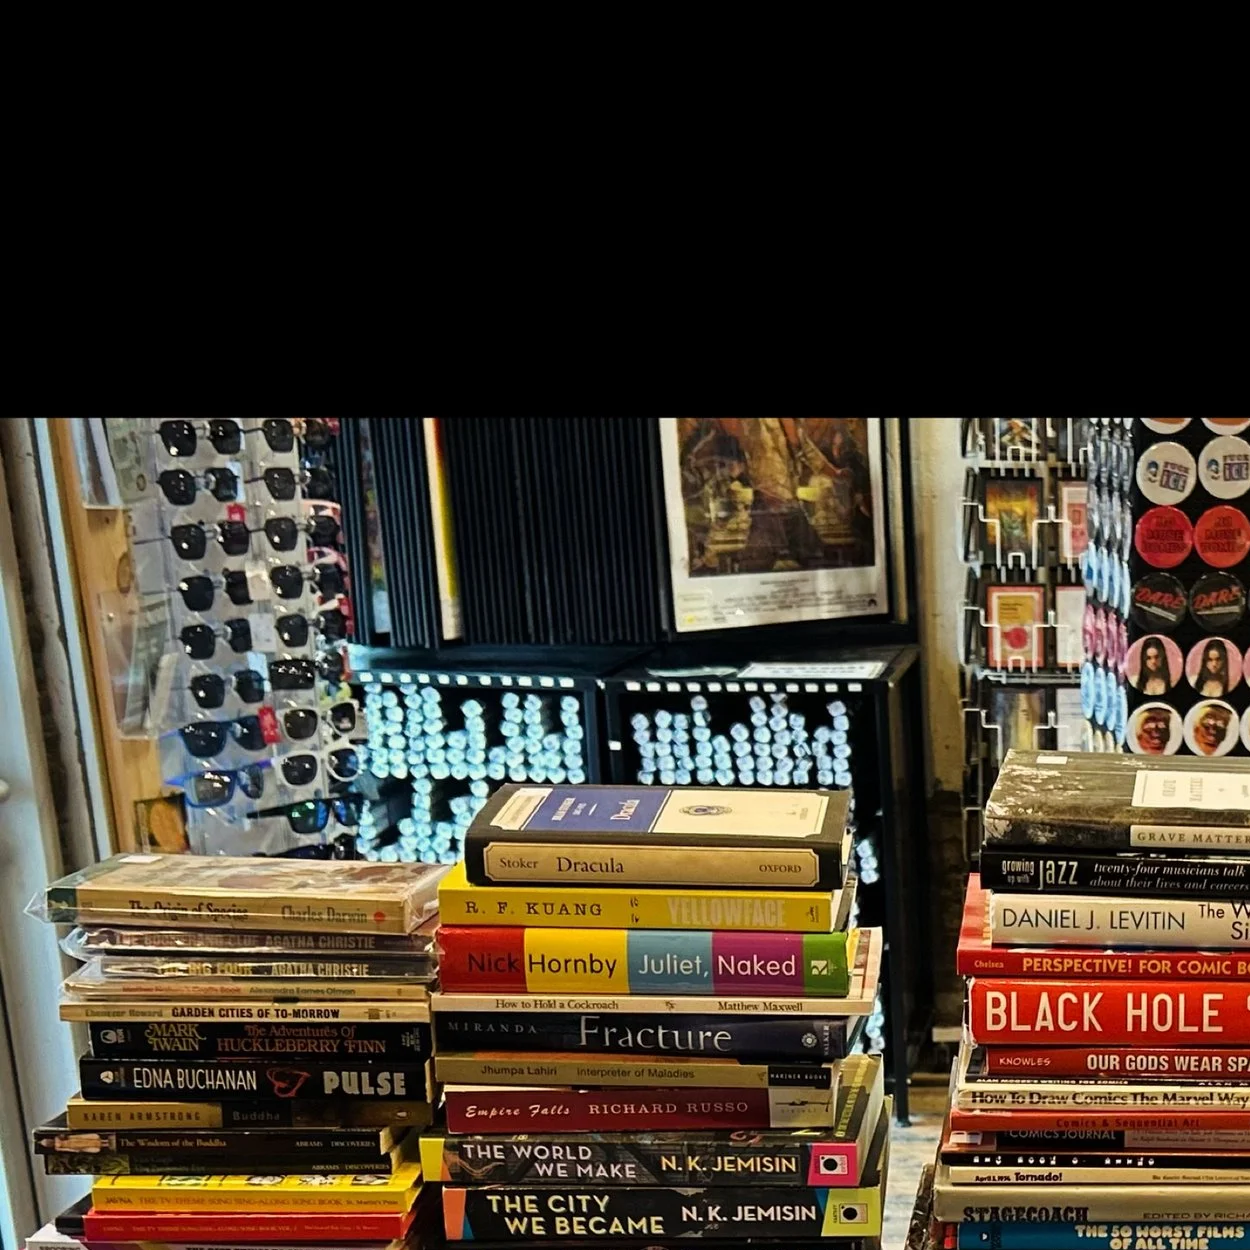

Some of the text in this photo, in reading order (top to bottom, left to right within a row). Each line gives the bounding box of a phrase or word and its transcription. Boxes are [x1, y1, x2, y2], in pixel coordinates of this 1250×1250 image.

[1137, 832, 1187, 844] GRAVE
[500, 857, 538, 871] Stoker
[557, 857, 624, 874] Dracula
[759, 864, 802, 873] OXFORD
[281, 906, 368, 924] Charles Darwin
[465, 902, 603, 916] R. F. KUANG
[1002, 910, 1185, 931] DANIEL J. LEVITIN
[468, 954, 617, 978] Nick Hornby
[638, 954, 796, 979] Juliet, Naked
[1023, 958, 1133, 973] PERSPECTIVE!
[1139, 960, 1172, 974] FOR
[1176, 960, 1232, 975] COMIC
[172, 1007, 340, 1019] GARDEN CITIES OF TO-MORROW
[718, 1002, 802, 1011] Matthew Maxwell
[986, 992, 1224, 1033] BLACK HOLE
[144, 1024, 200, 1039] MARK
[579, 1016, 732, 1051] Fracture
[147, 1036, 200, 1051] TWAIN
[218, 1039, 386, 1053] HUCKLEBERRY FINN
[1087, 1055, 1120, 1070] OUR
[1125, 1055, 1169, 1071] GODS
[1174, 1056, 1223, 1072] WEAR
[134, 1069, 257, 1091] EDNA BUCHANAN
[323, 1072, 406, 1096] PULSE
[589, 1102, 748, 1115] RICHARD RUSSO
[463, 1145, 592, 1160] THE WORLD
[535, 1163, 637, 1178] WE MAKE
[661, 1156, 797, 1172] N. K. JEMISIN
